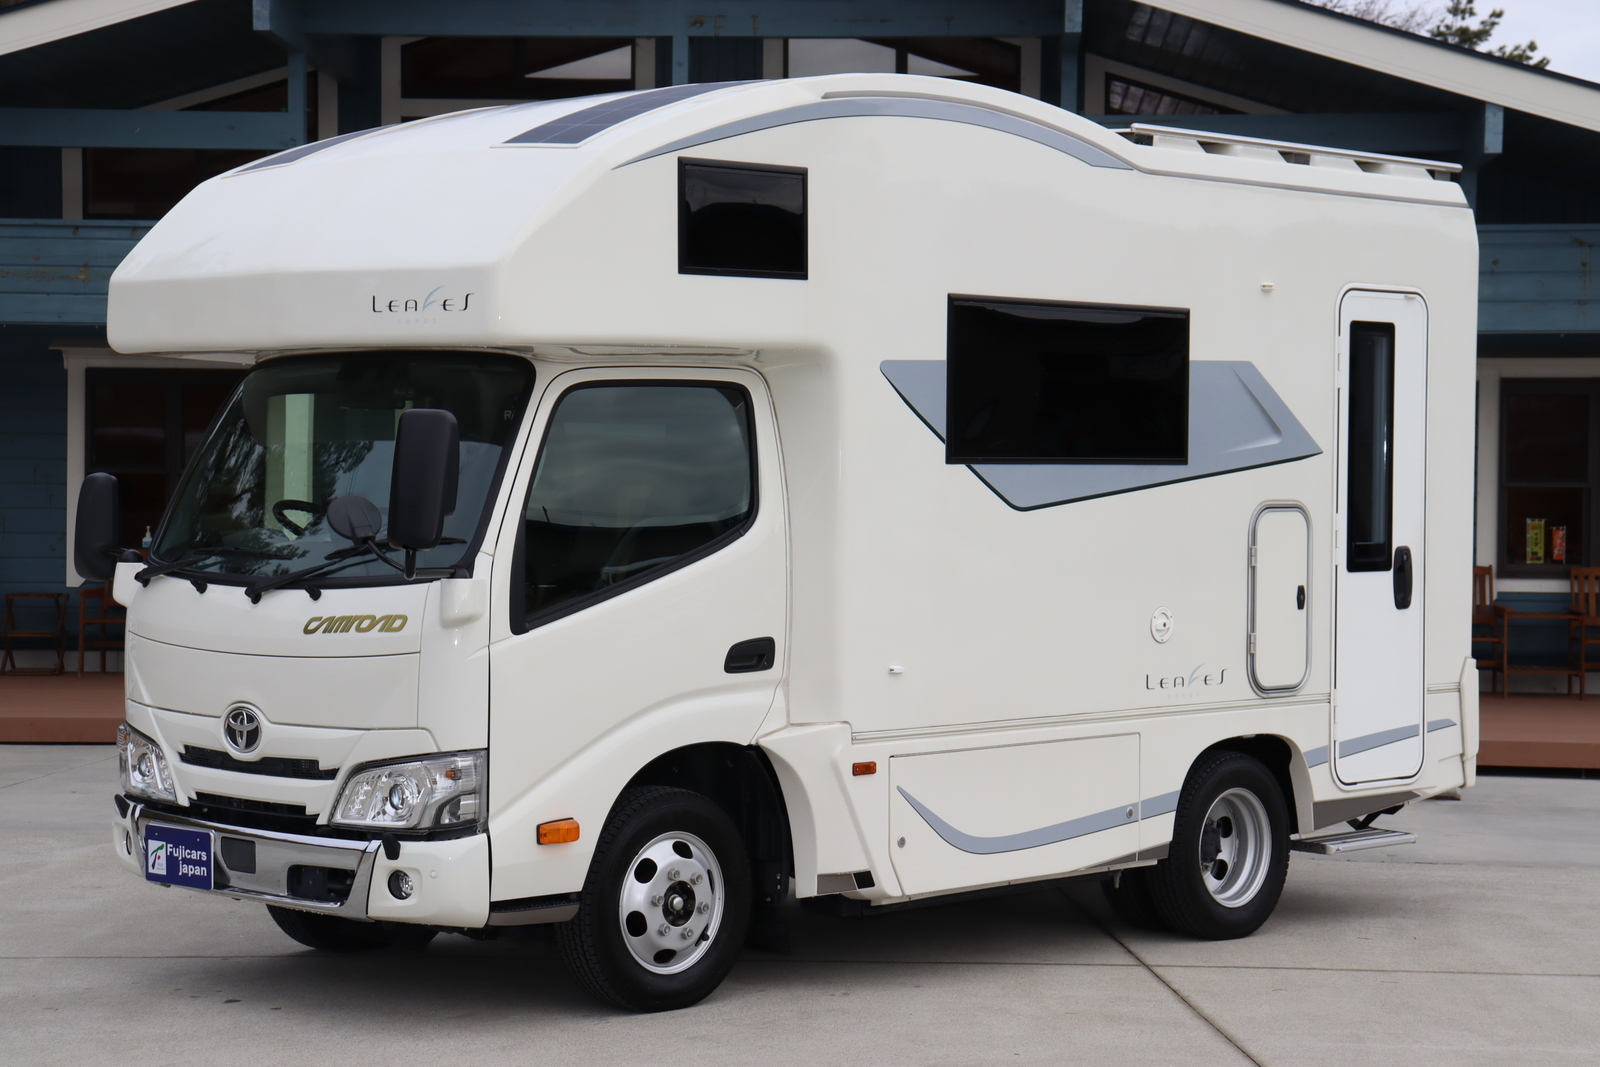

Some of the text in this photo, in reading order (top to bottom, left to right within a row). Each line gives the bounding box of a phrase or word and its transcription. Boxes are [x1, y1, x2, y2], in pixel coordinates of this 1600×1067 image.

[303, 614, 409, 635] CAMROAD
[167, 843, 207, 861] Fujicars
[179, 860, 207, 877] japan
